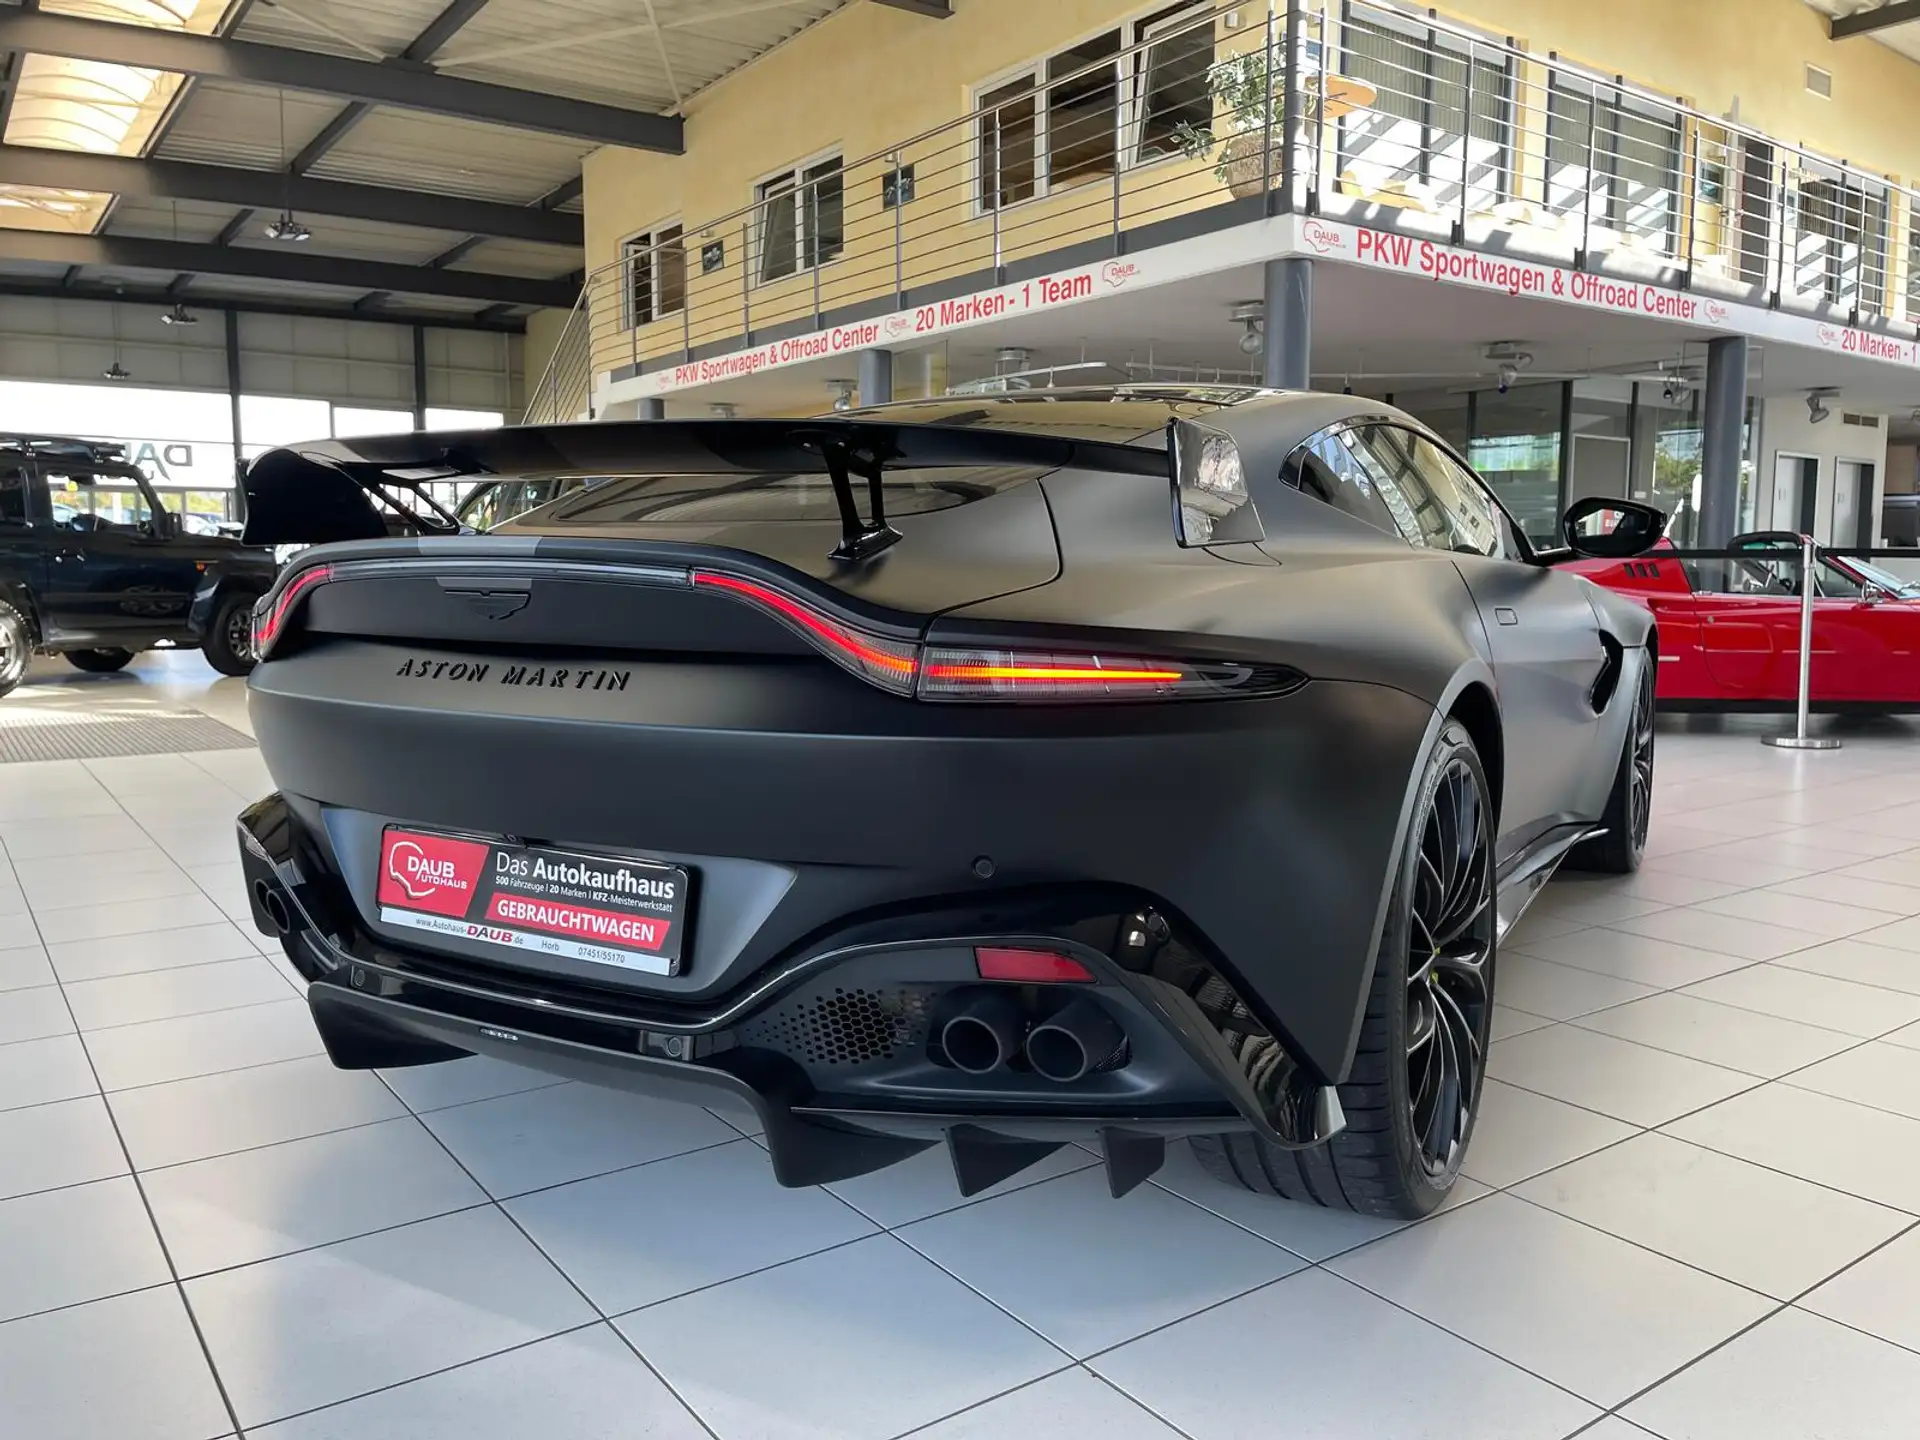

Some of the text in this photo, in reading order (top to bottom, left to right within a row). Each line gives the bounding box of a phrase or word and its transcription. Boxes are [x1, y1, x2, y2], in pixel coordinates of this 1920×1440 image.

[1356, 229, 1697, 319] PKW Sportwagen & Offroad Center
[915, 307, 935, 332] 20
[940, 294, 1004, 326] Marken
[1022, 283, 1030, 308] 1
[1039, 274, 1091, 303] Team
[675, 364, 699, 385] PKW
[701, 351, 766, 384] Sportwagen
[769, 345, 778, 365] &
[781, 332, 828, 361] Offroad
[832, 324, 879, 350] Center
[1841, 329, 1857, 351] 20
[1859, 330, 1901, 360] Marken
[396, 658, 631, 691] ASTON MARTIN
[407, 855, 455, 881] DAUB
[496, 851, 675, 898] Das Autokaufhaus
[495, 875, 509, 886] 500
[510, 877, 545, 893] Fahrzeuge
[550, 884, 559, 894] 20
[561, 887, 587, 899] Marken
[592, 891, 673, 912] KFZ-Meisterwerkstatt
[497, 899, 655, 942] GEBRAUCHTWAGEN
[541, 940, 560, 952] Horb
